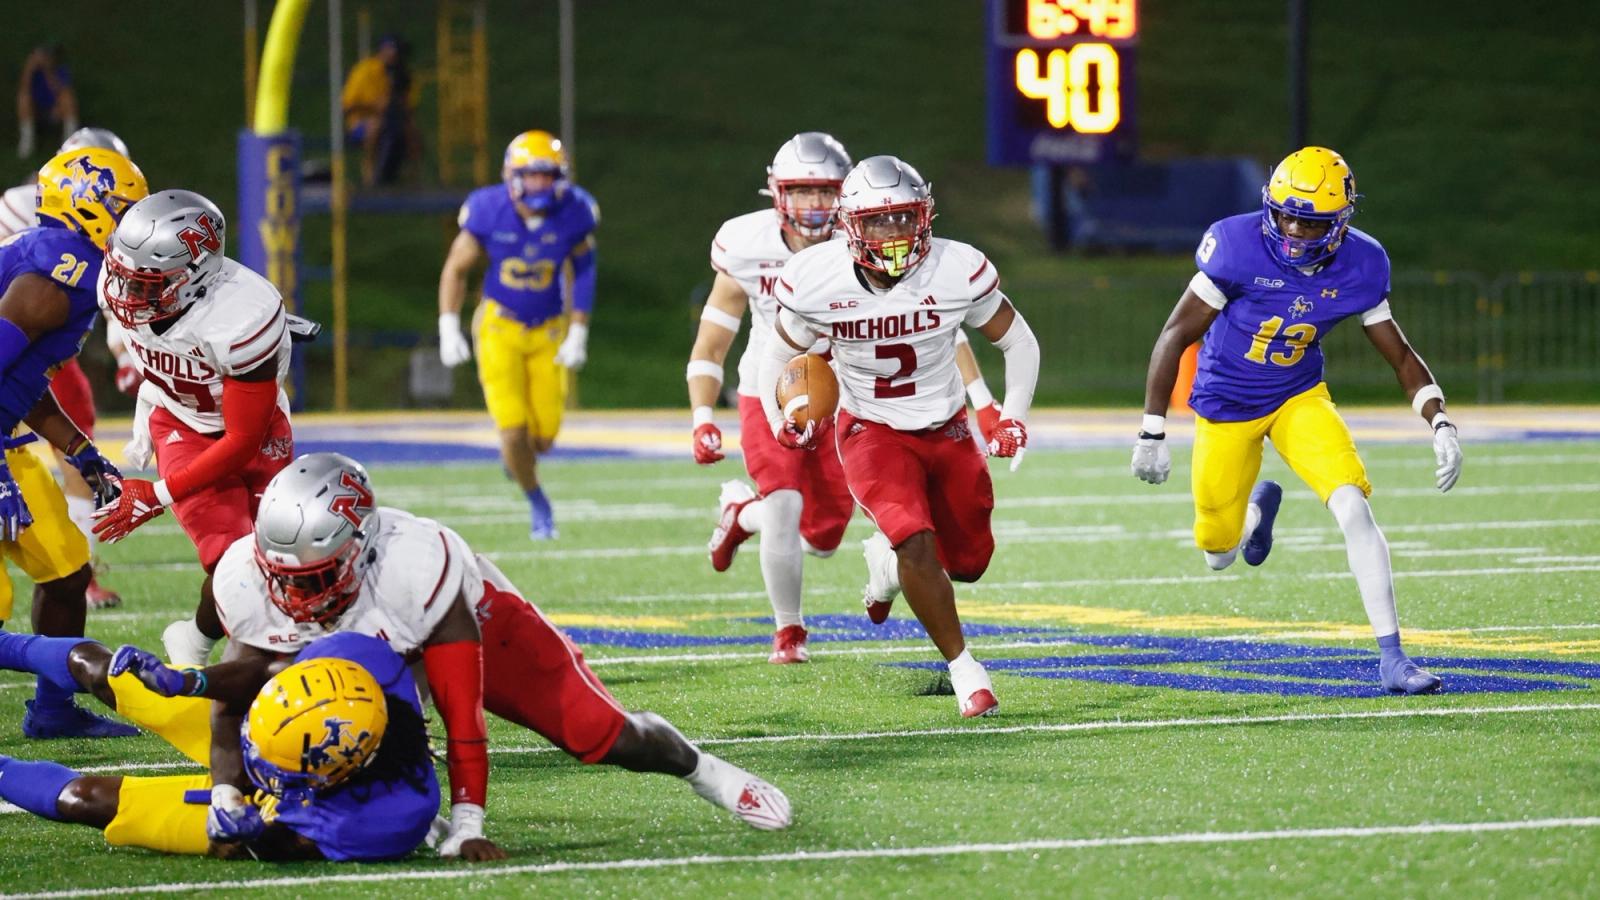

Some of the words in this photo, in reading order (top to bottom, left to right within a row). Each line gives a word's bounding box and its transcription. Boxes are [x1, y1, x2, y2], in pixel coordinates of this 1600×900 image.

[1016, 43, 1120, 133] 40
[51, 253, 89, 287] 21
[1254, 277, 1286, 289] SLC
[829, 300, 859, 310] SLC
[832, 309, 941, 339] NICHOLLS
[1244, 315, 1317, 367] 13
[874, 343, 917, 399] 2
[328, 470, 374, 529] N
[268, 633, 301, 644] SLC
